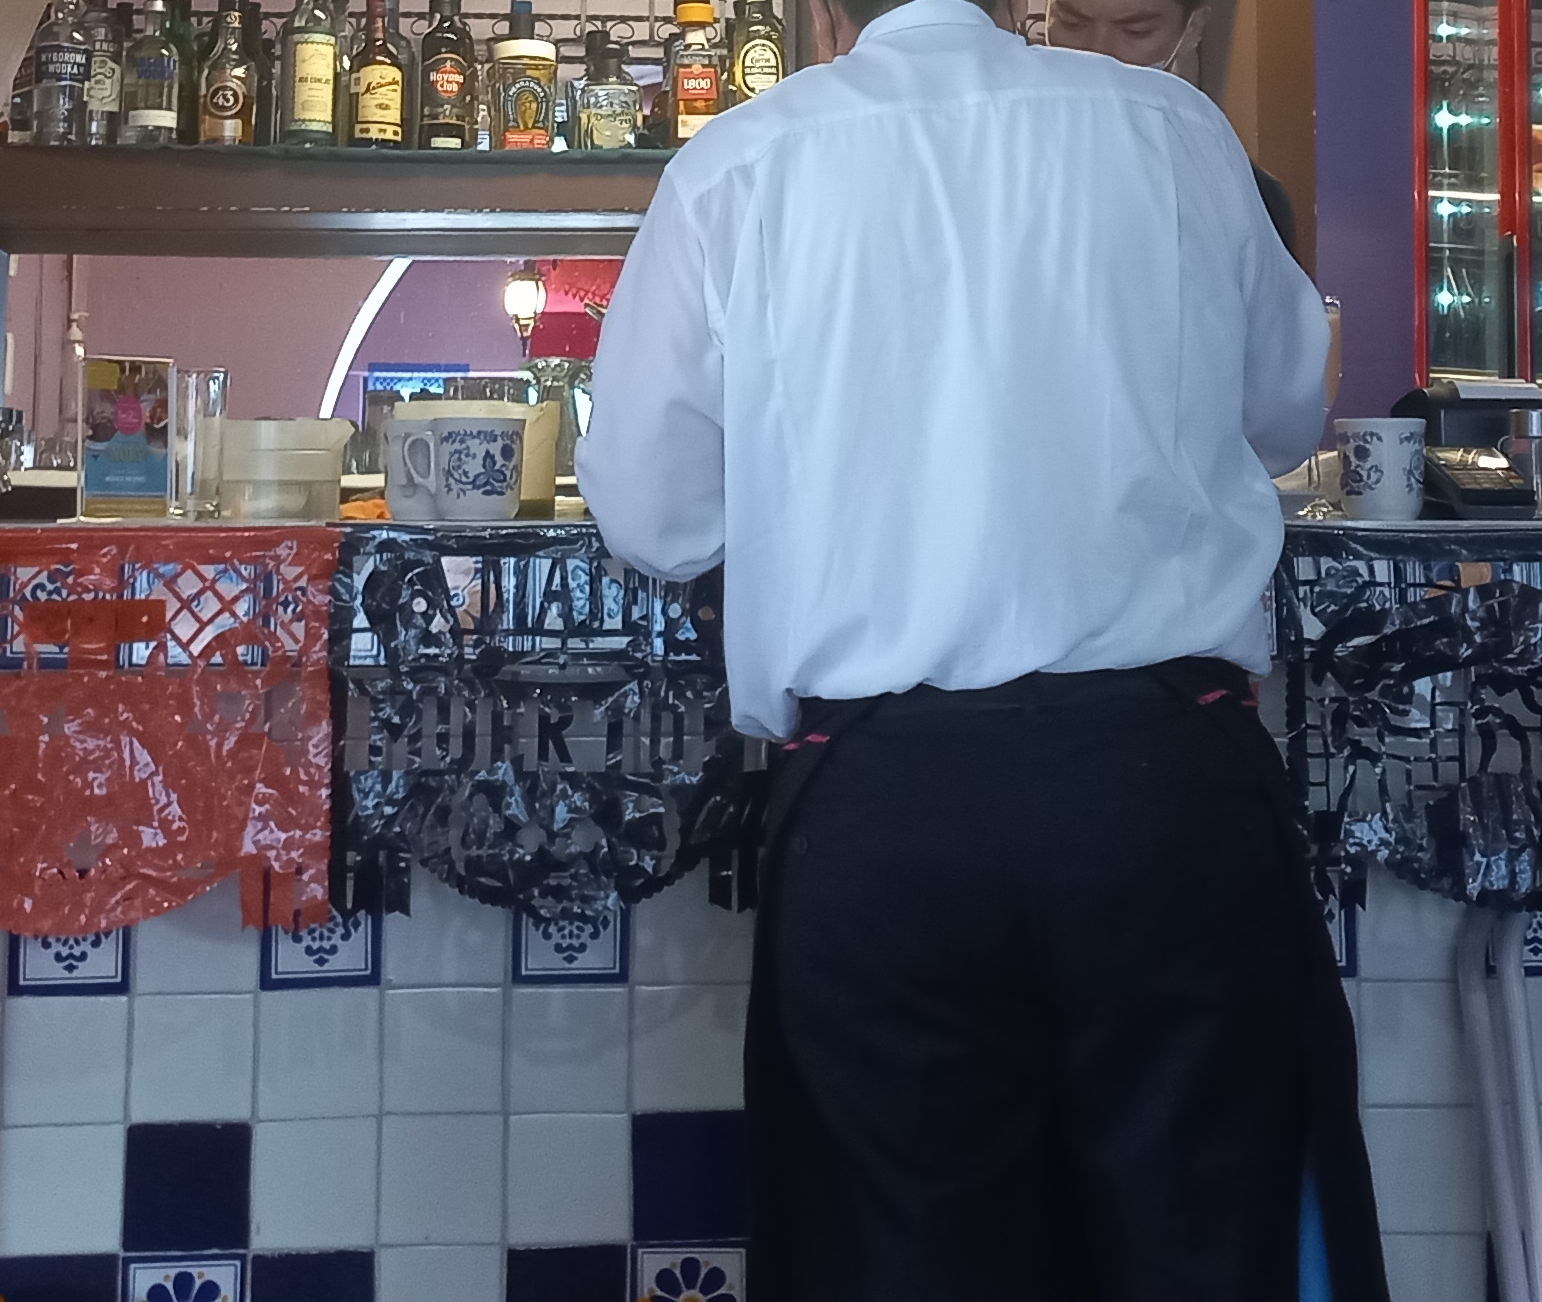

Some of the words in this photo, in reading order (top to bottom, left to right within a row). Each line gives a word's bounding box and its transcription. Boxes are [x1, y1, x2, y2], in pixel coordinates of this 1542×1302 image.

[40, 51, 87, 64] WYBOROWA
[48, 62, 79, 75] WODKA
[430, 71, 464, 84] Havana
[683, 78, 712, 90] 1800
[437, 80, 459, 92] Club
[212, 89, 234, 107] 43
